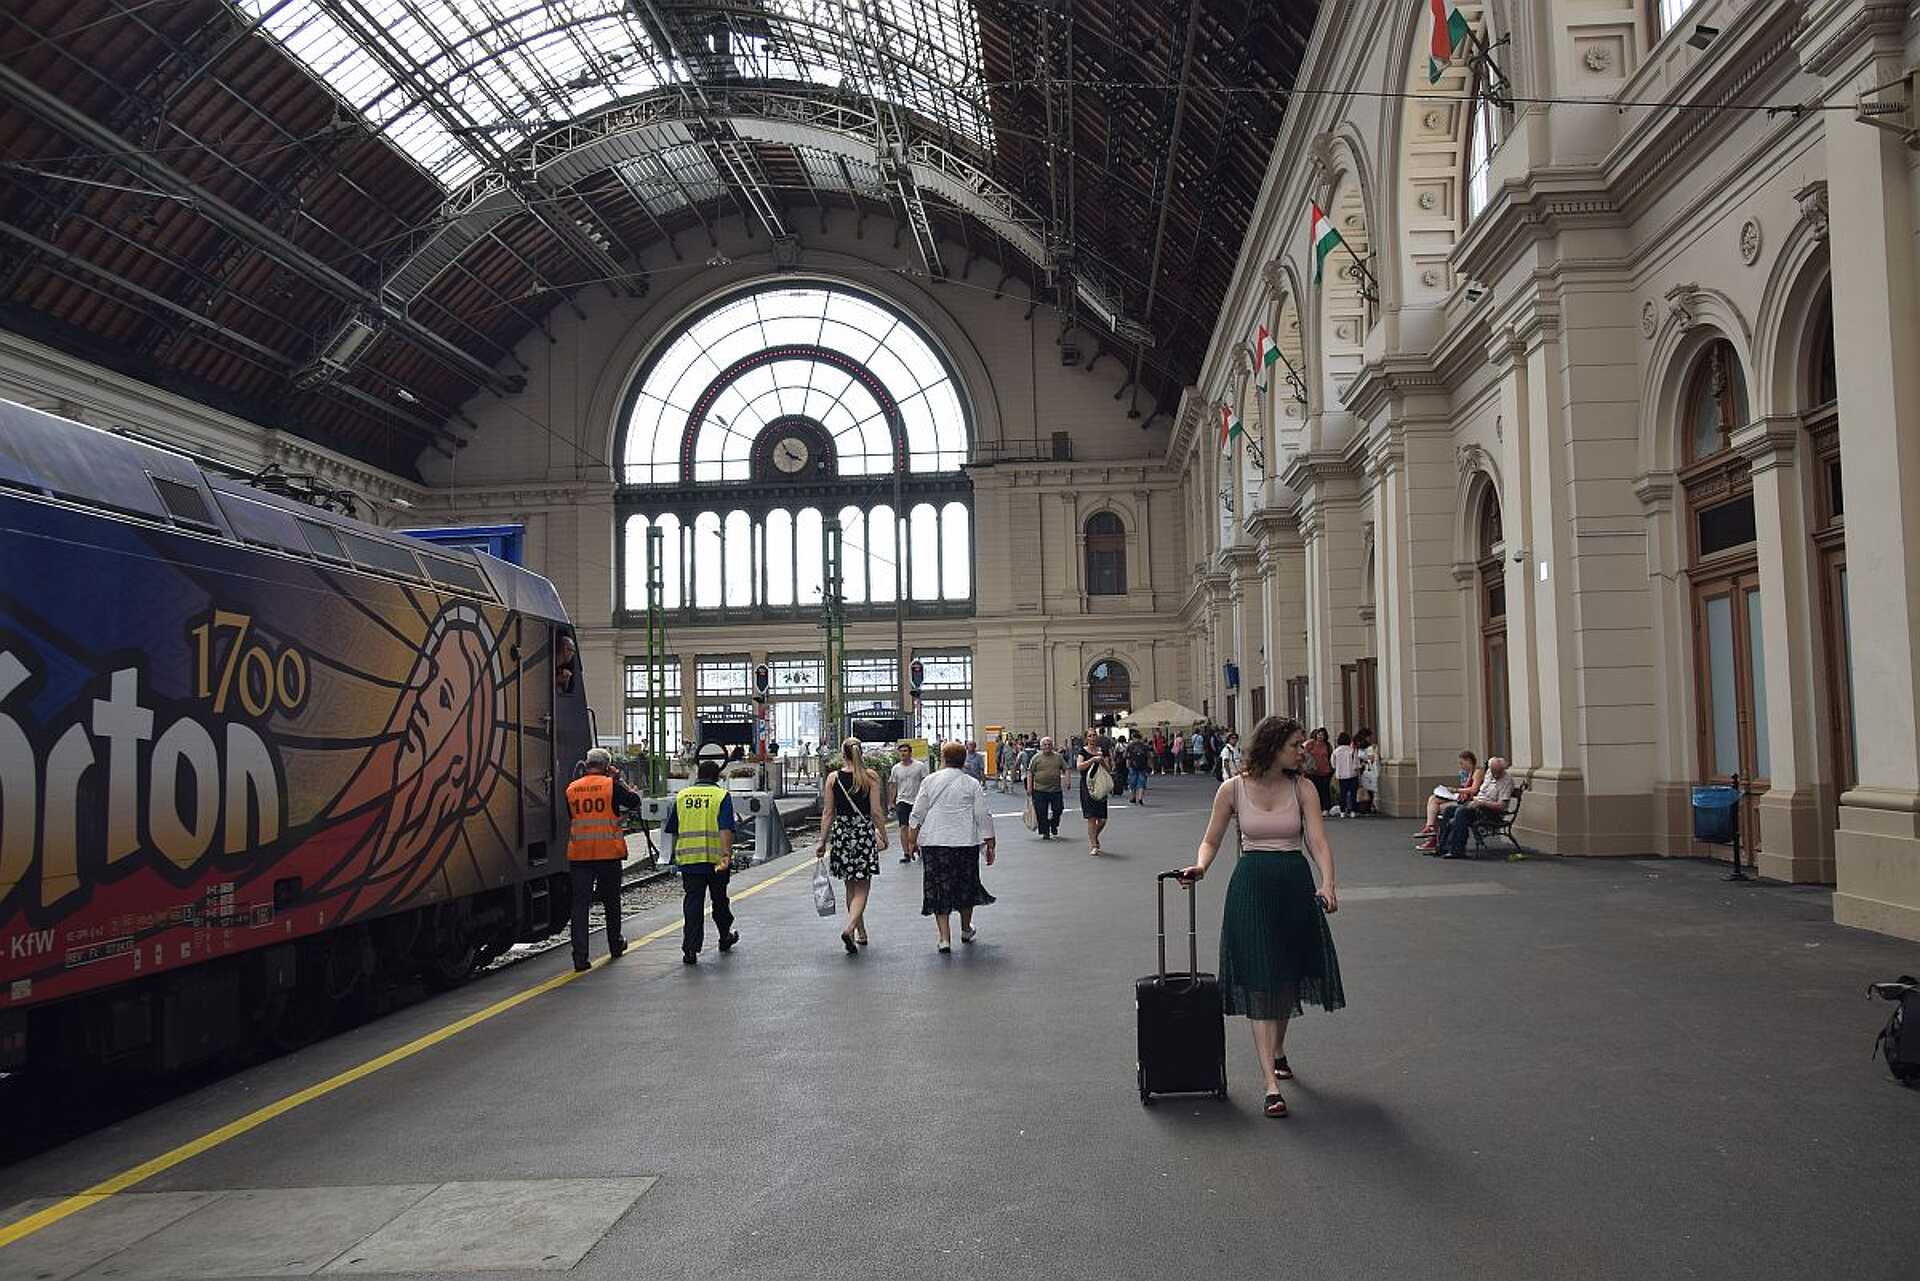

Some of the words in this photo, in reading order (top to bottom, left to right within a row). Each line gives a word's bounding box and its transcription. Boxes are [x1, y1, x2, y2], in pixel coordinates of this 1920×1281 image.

[191, 608, 307, 717] 1700
[571, 797, 605, 815] 100
[684, 797, 710, 809] 981
[11, 928, 55, 959] KfW
